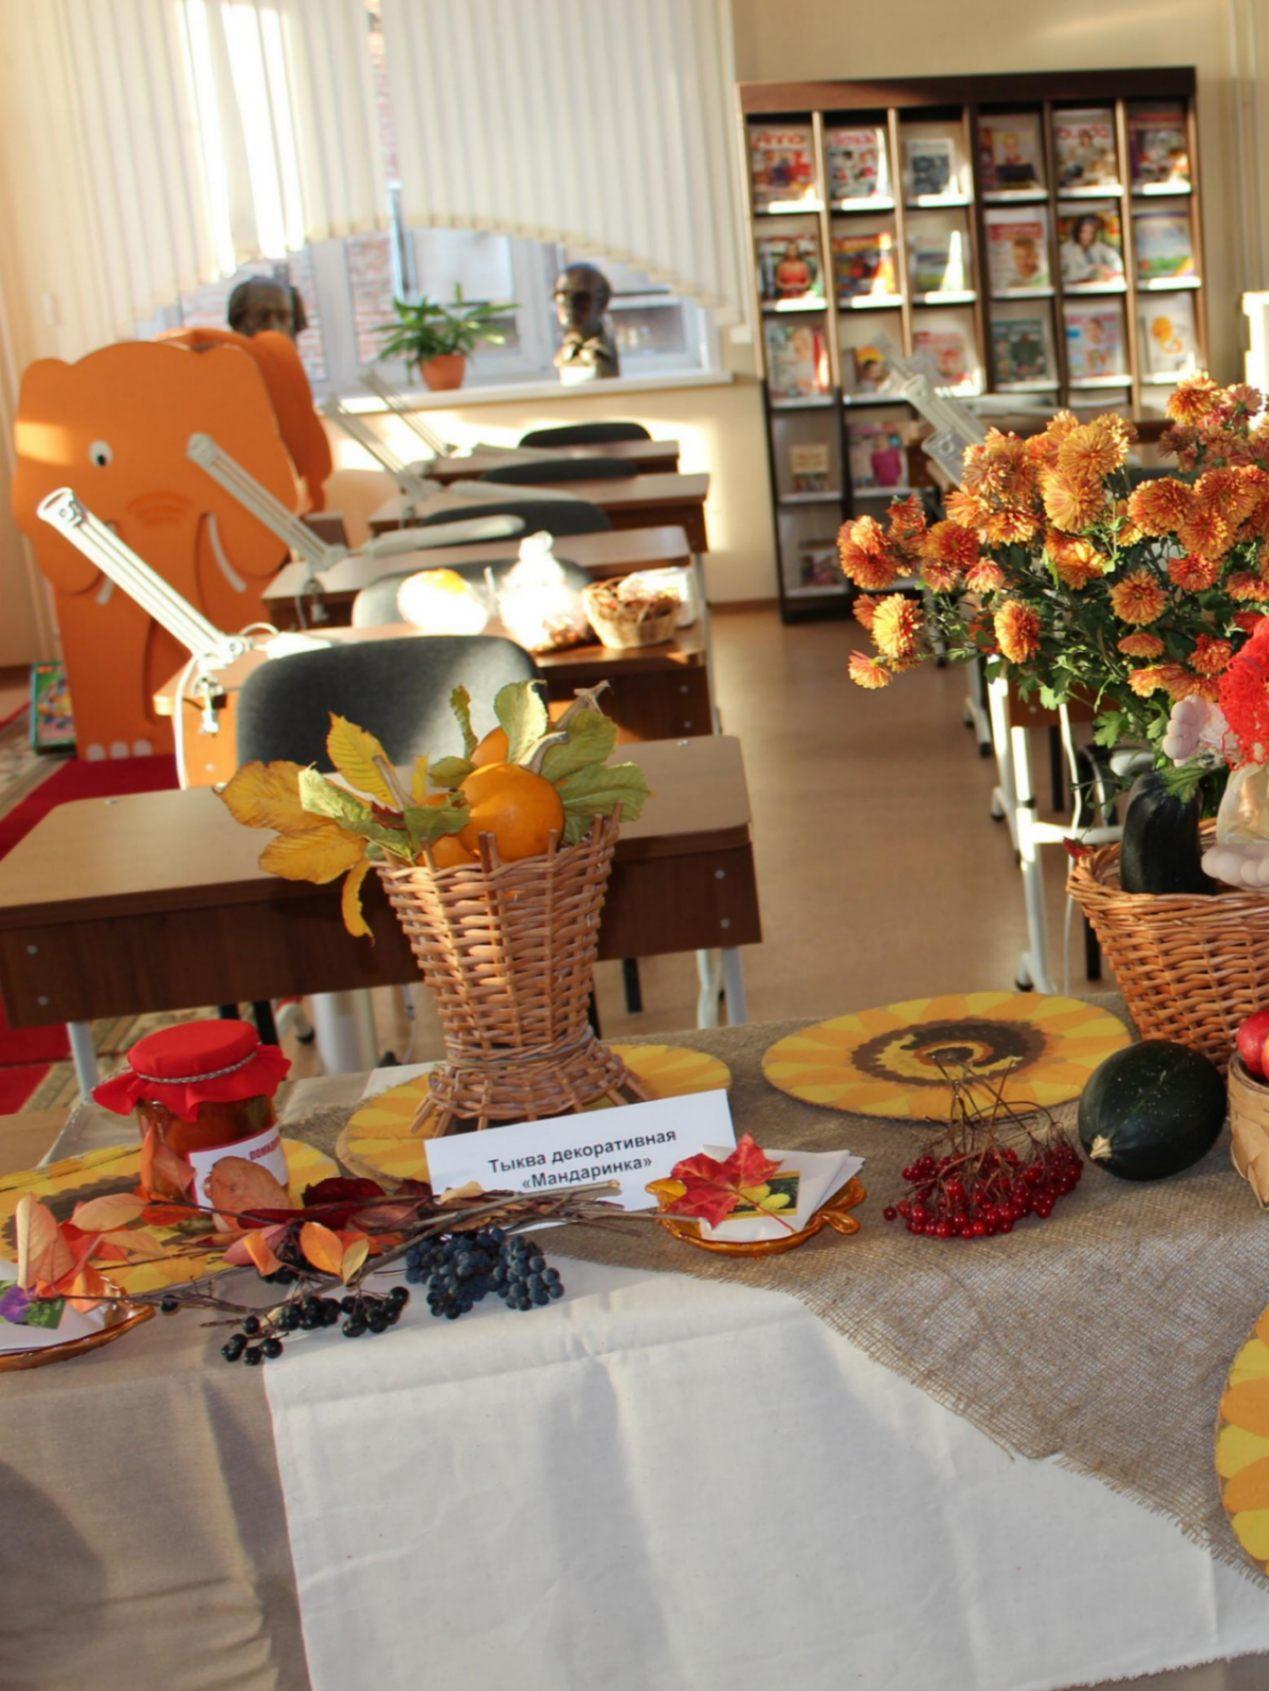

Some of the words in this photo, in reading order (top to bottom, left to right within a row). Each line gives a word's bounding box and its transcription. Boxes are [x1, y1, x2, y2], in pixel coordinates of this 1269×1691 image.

[488, 1151, 547, 1174] Тыква
[551, 1129, 677, 1164] декоративная
[522, 1157, 653, 1189] «Мандаринка»
